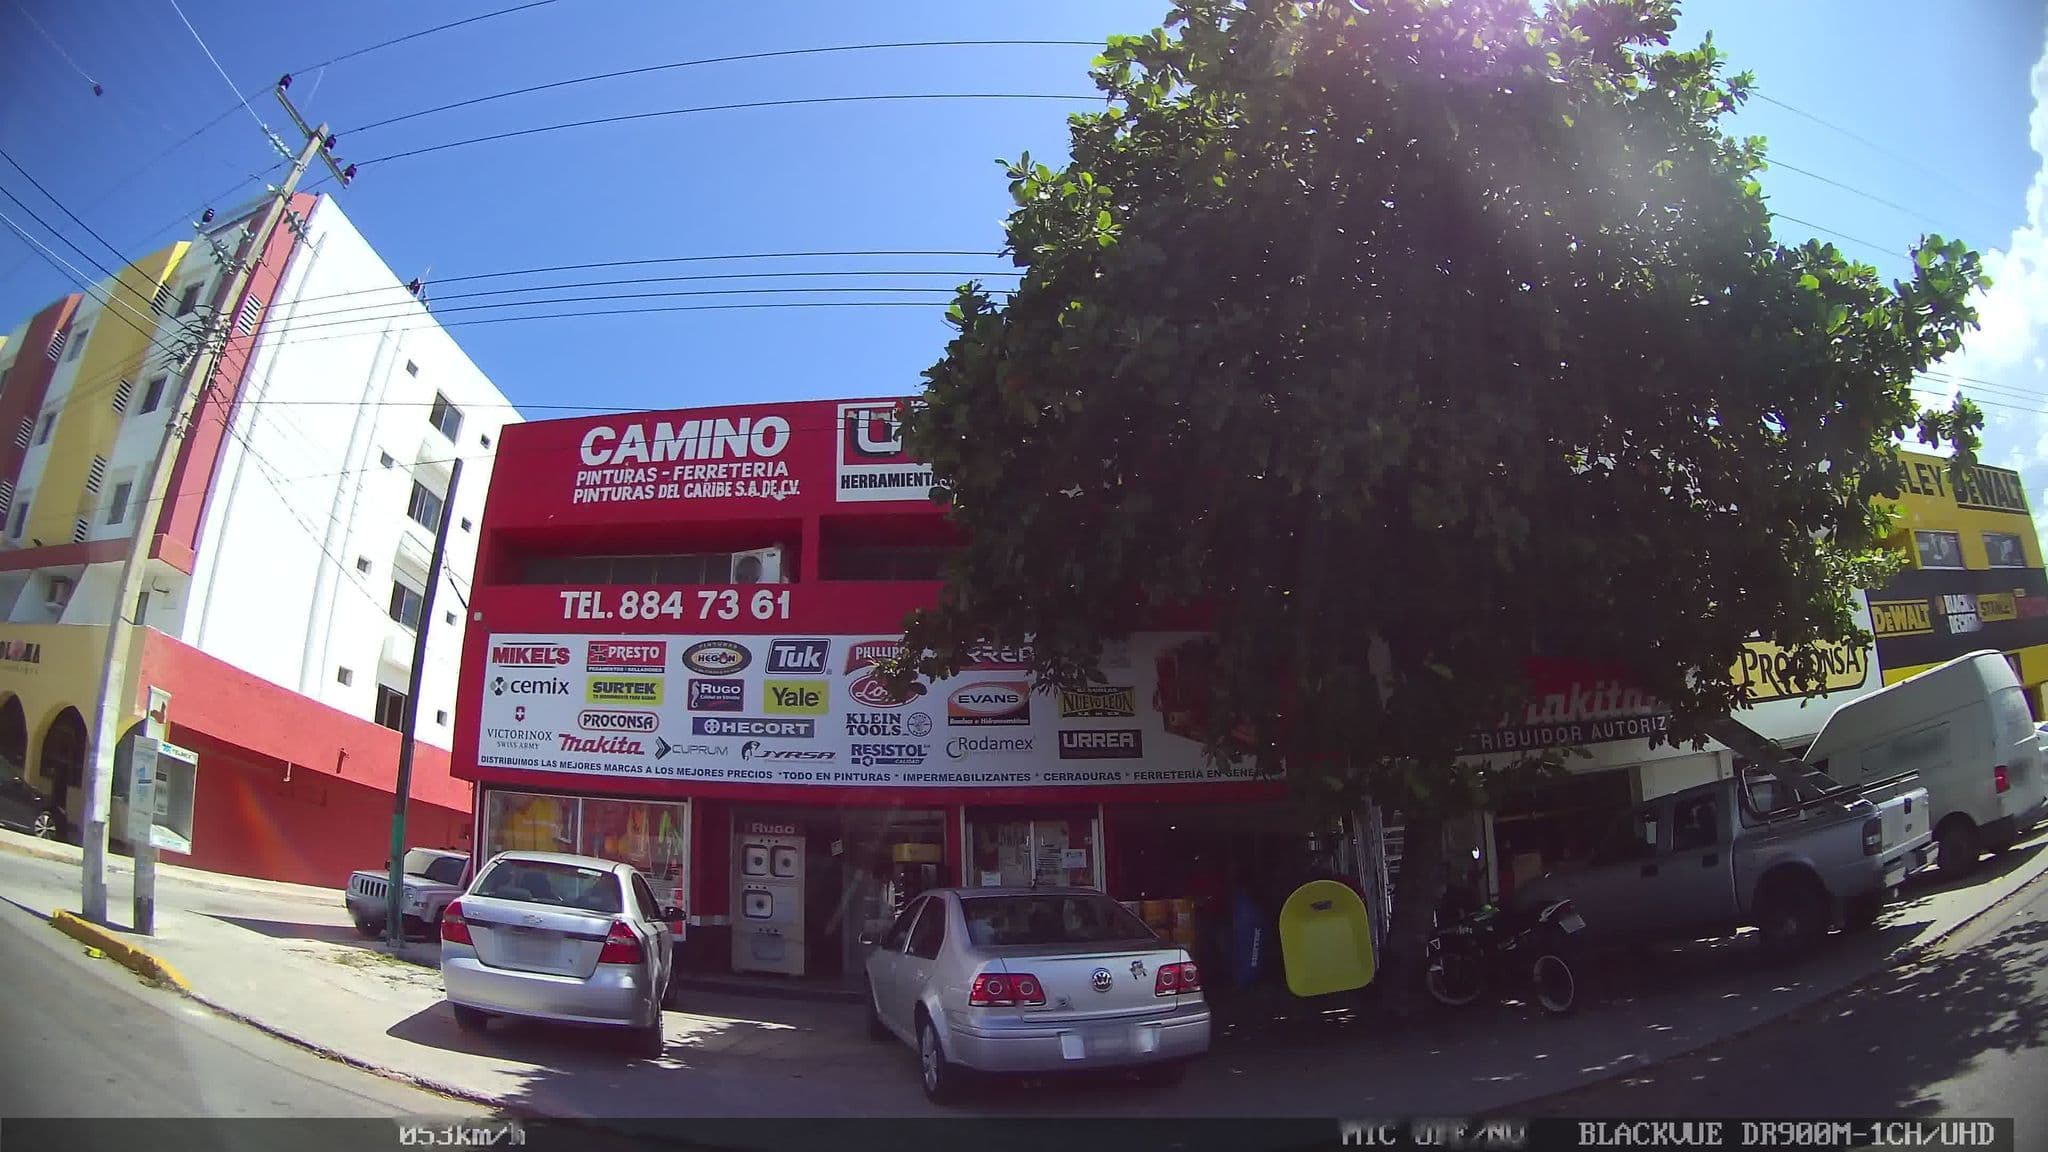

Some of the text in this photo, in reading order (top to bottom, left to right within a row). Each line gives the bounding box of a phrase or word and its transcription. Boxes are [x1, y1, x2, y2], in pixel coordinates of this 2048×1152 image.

[580, 416, 792, 466] CAMINO
[576, 467, 657, 486] PINTURAS
[673, 461, 789, 481] FERRETERIA
[573, 485, 654, 504] PINTURAS
[658, 484, 680, 499] DEL
[684, 480, 732, 498] CARIBE
[560, 590, 791, 620] TEL. 884 73 61
[608, 646, 660, 662] PRESTO
[777, 646, 821, 669] Tuk
[511, 678, 570, 696] cemix
[592, 682, 657, 695] SURTEK
[772, 687, 820, 707] Yale
[958, 695, 1019, 704] EVANS
[583, 713, 653, 730] PROCONSA
[846, 713, 901, 725] KLEIN
[487, 728, 552, 742] VICTORINOX
[721, 721, 809, 736] HECORT
[845, 724, 901, 736] TOOLS
[958, 736, 1033, 751] Rodamex
[1063, 732, 1134, 749] URREA
[672, 744, 728, 756] CUPRUM
[852, 744, 926, 757] RESISTOL
[480, 755, 540, 768] DISTRIBUIMOS
[541, 759, 558, 768] LAS
[559, 761, 601, 771] MEJORES
[604, 764, 643, 774] MARCAS
[645, 766, 652, 774] A
[655, 767, 674, 776] LOS
[676, 767, 724, 778] MEJORES
[727, 769, 773, 780] PRECIOS
[816, 771, 831, 781] EN
[834, 772, 891, 782] PINTURAS
[903, 773, 1032, 783] IMPERMEABILIZANTES
[1043, 772, 1122, 782] CERRADURAS
[1207, 770, 1221, 778] EN
